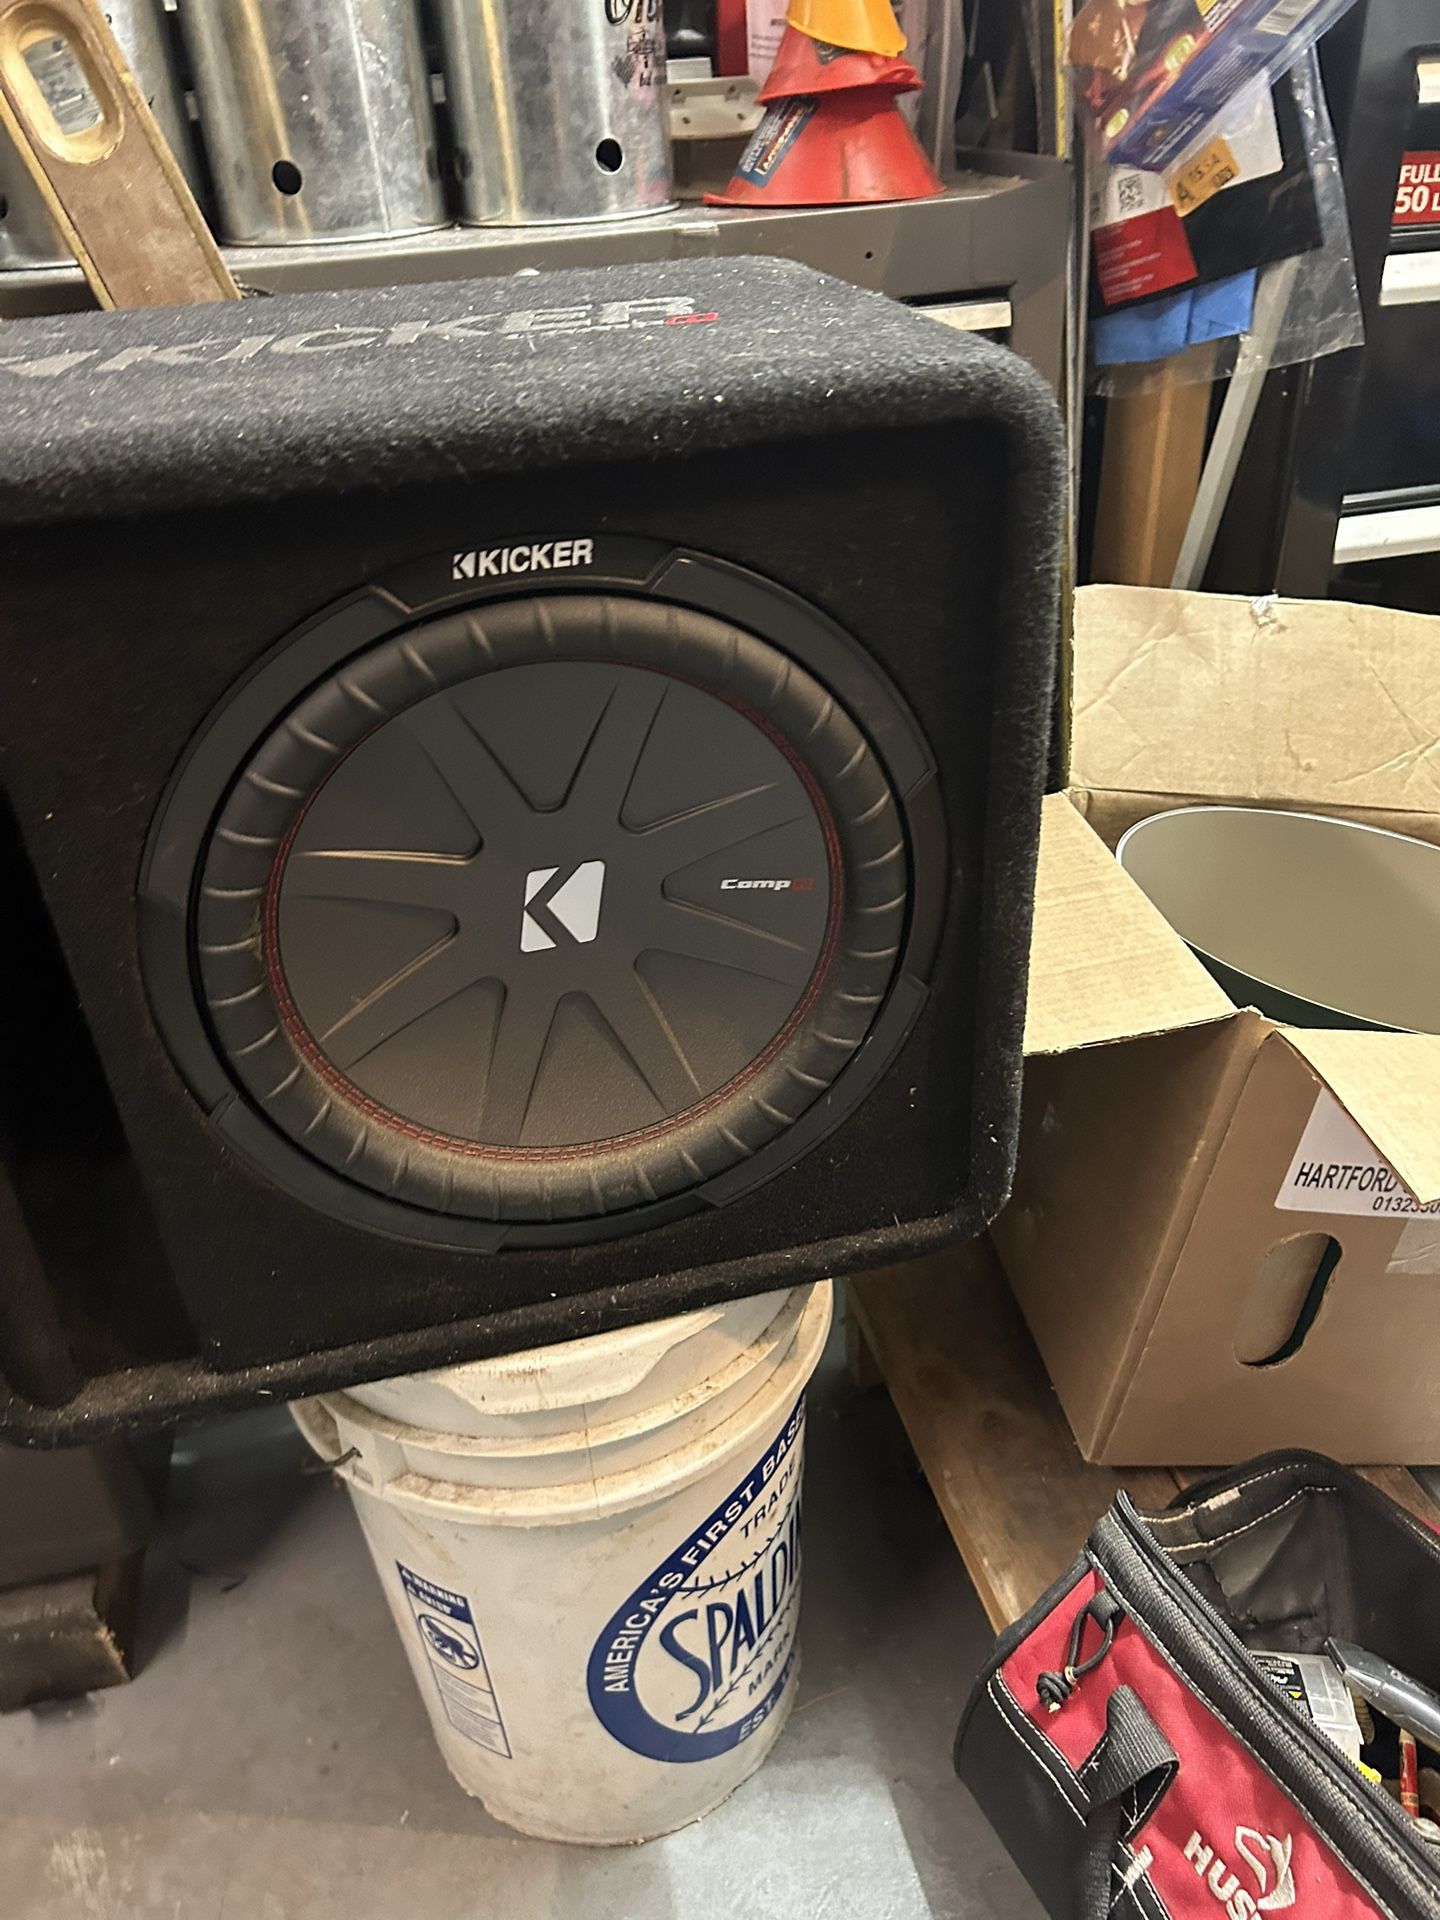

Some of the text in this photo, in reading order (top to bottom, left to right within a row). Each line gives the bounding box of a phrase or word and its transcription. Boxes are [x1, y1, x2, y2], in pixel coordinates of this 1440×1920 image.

[1399, 164, 1440, 185] FULL
[1394, 185, 1430, 213] 50
[478, 538, 594, 577] KICKER
[603, 1571, 684, 1692] AMERICA'S
[681, 1480, 755, 1566] FIRST
[1183, 1830, 1262, 1920] HUS
